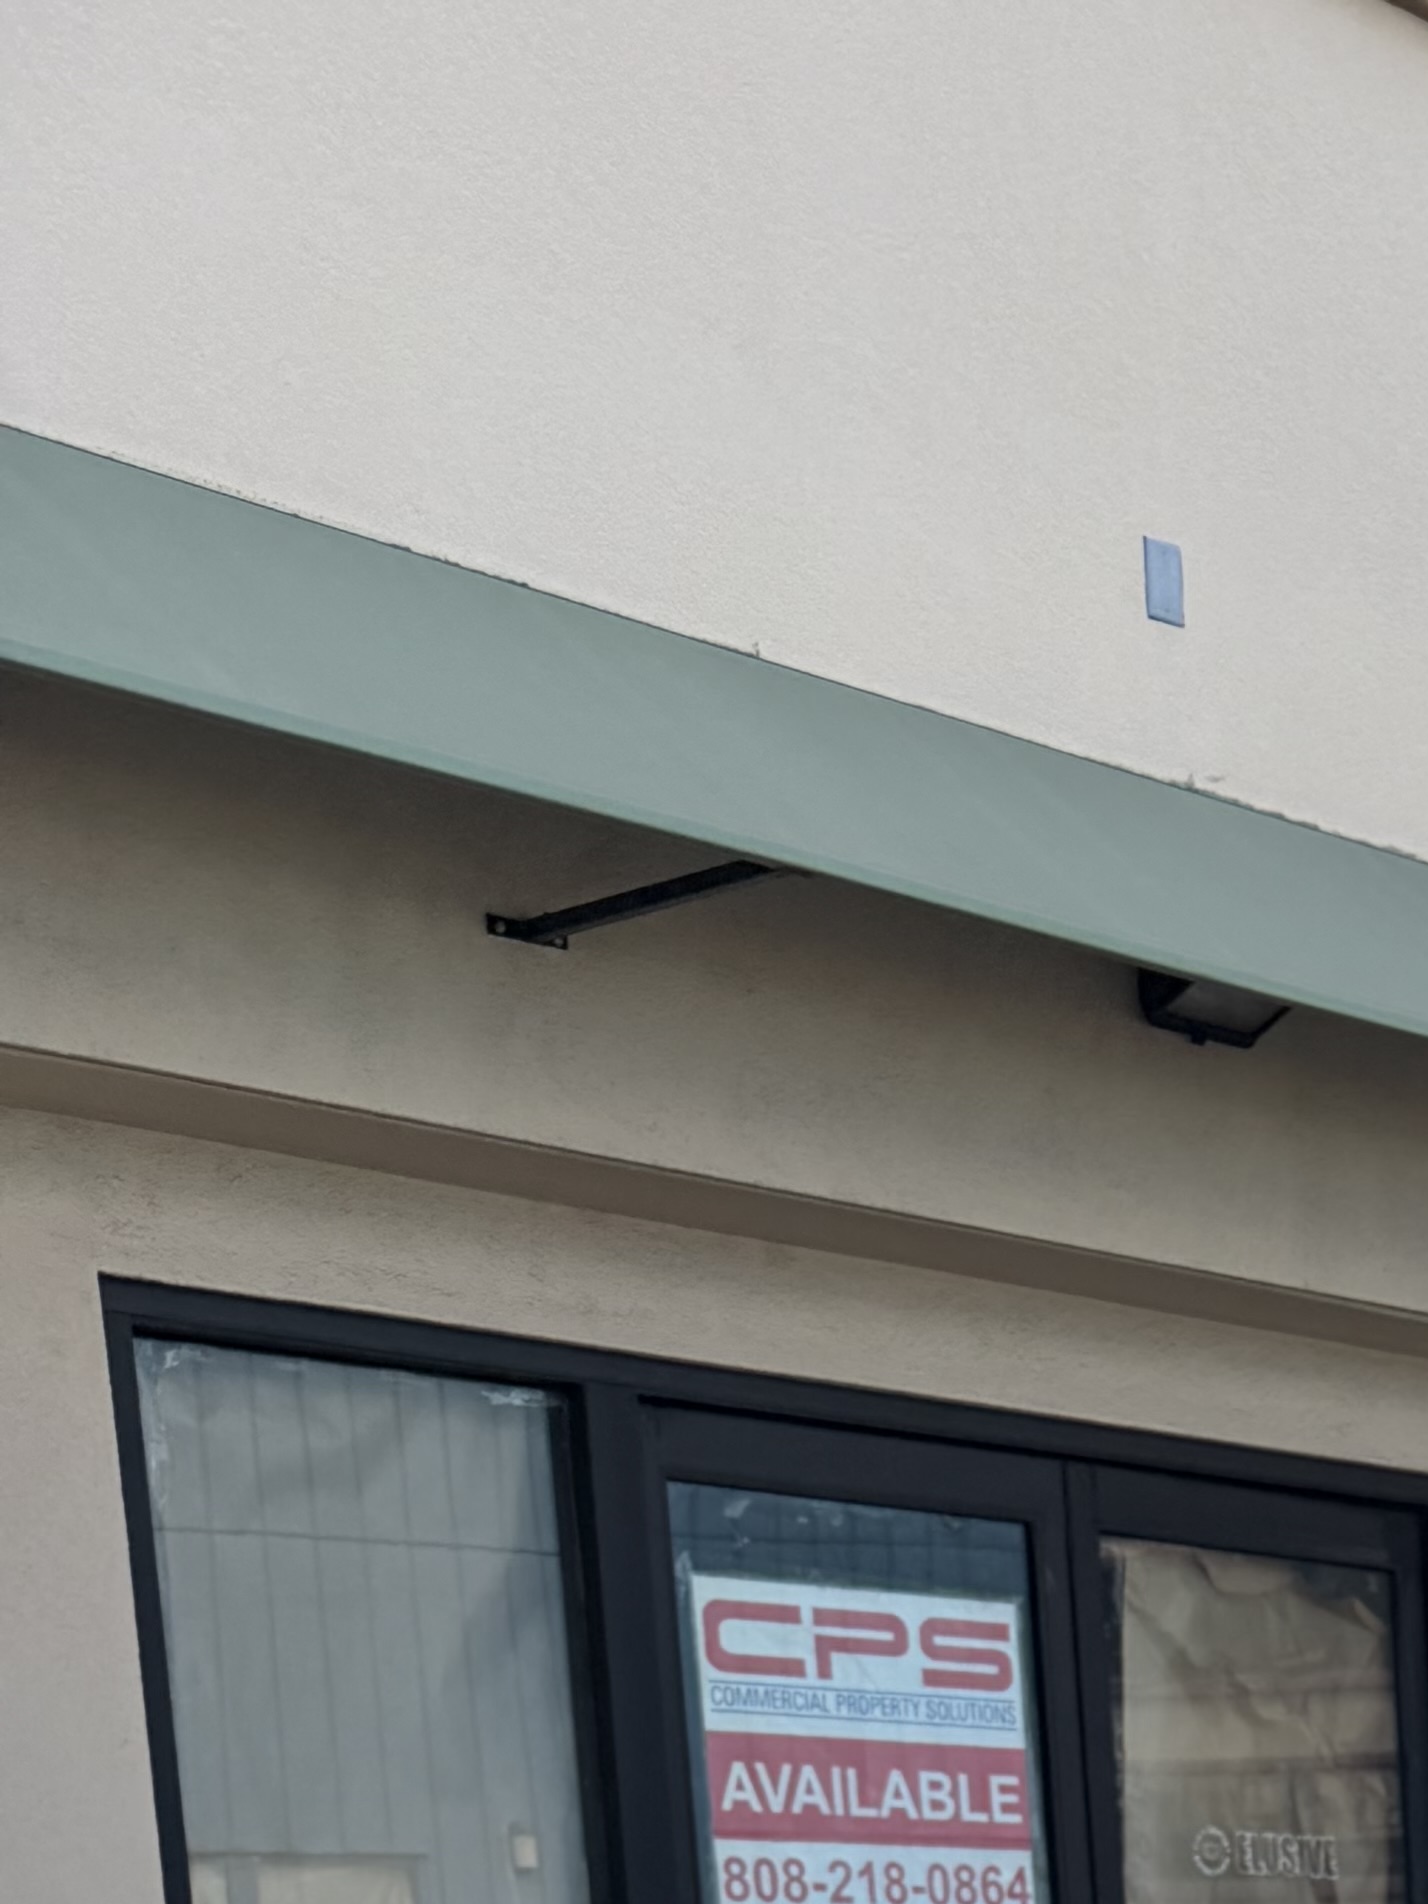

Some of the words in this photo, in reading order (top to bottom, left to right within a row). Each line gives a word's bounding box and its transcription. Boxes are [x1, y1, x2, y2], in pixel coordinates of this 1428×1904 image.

[702, 1599, 1014, 1693] CPS
[710, 1685, 830, 1714] COMMERCIAL
[835, 1693, 921, 1720] PROPERTY
[924, 1700, 1018, 1726] SOLUTIONS
[721, 1760, 1024, 1824] AVAILABLE
